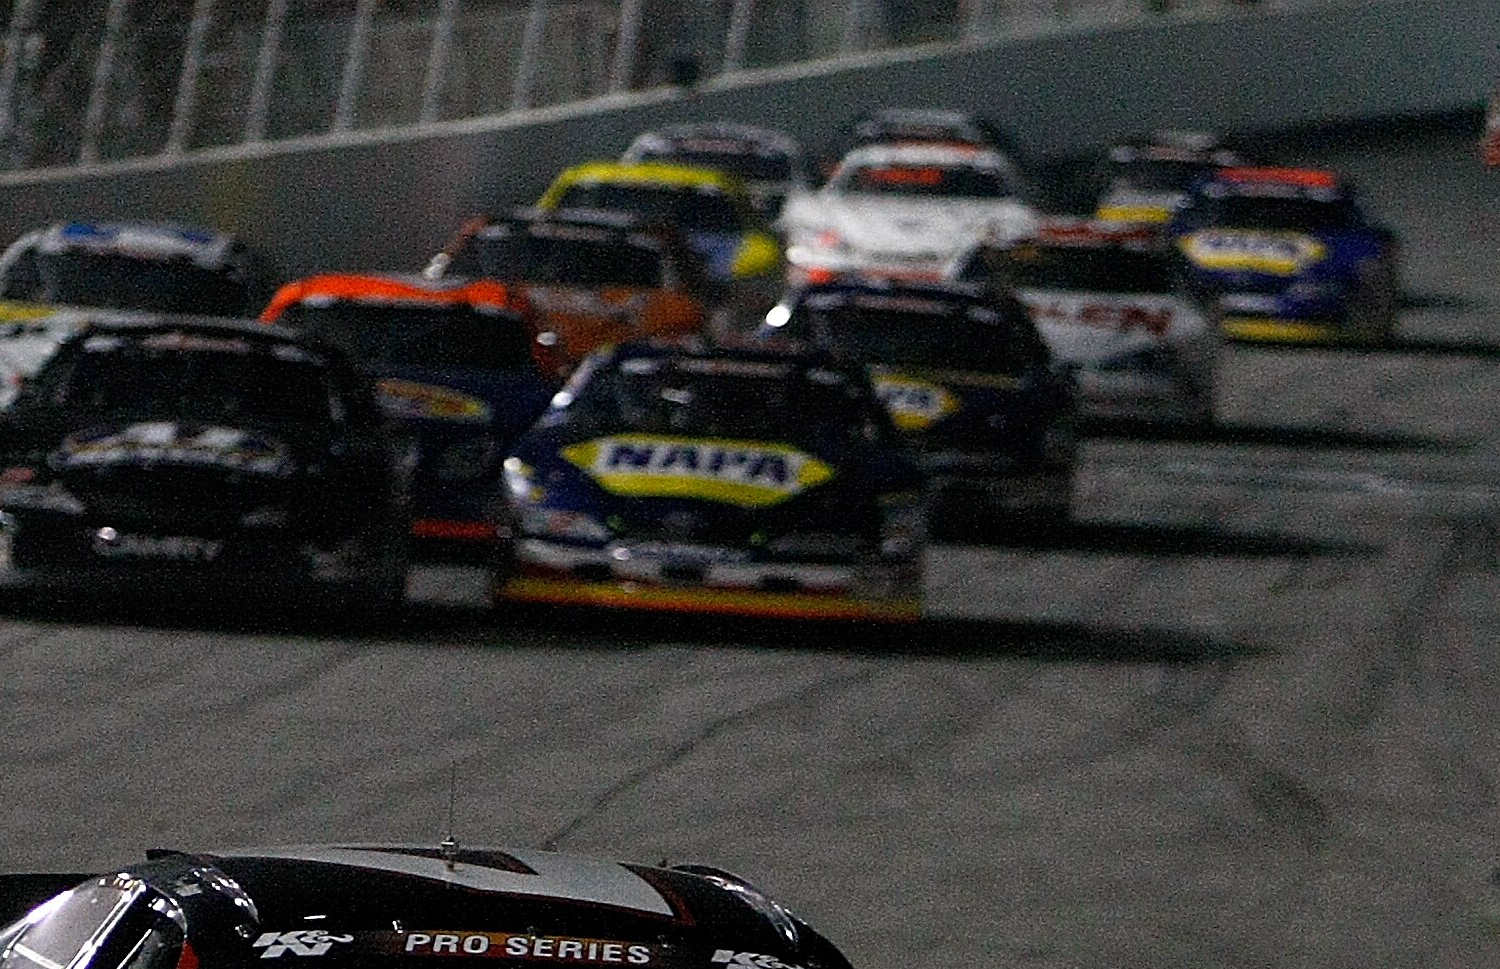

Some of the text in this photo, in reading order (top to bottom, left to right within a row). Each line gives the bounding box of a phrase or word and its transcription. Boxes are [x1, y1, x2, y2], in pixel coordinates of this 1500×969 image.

[609, 446, 787, 484] NAPA
[404, 932, 652, 964] PRO SERIES
